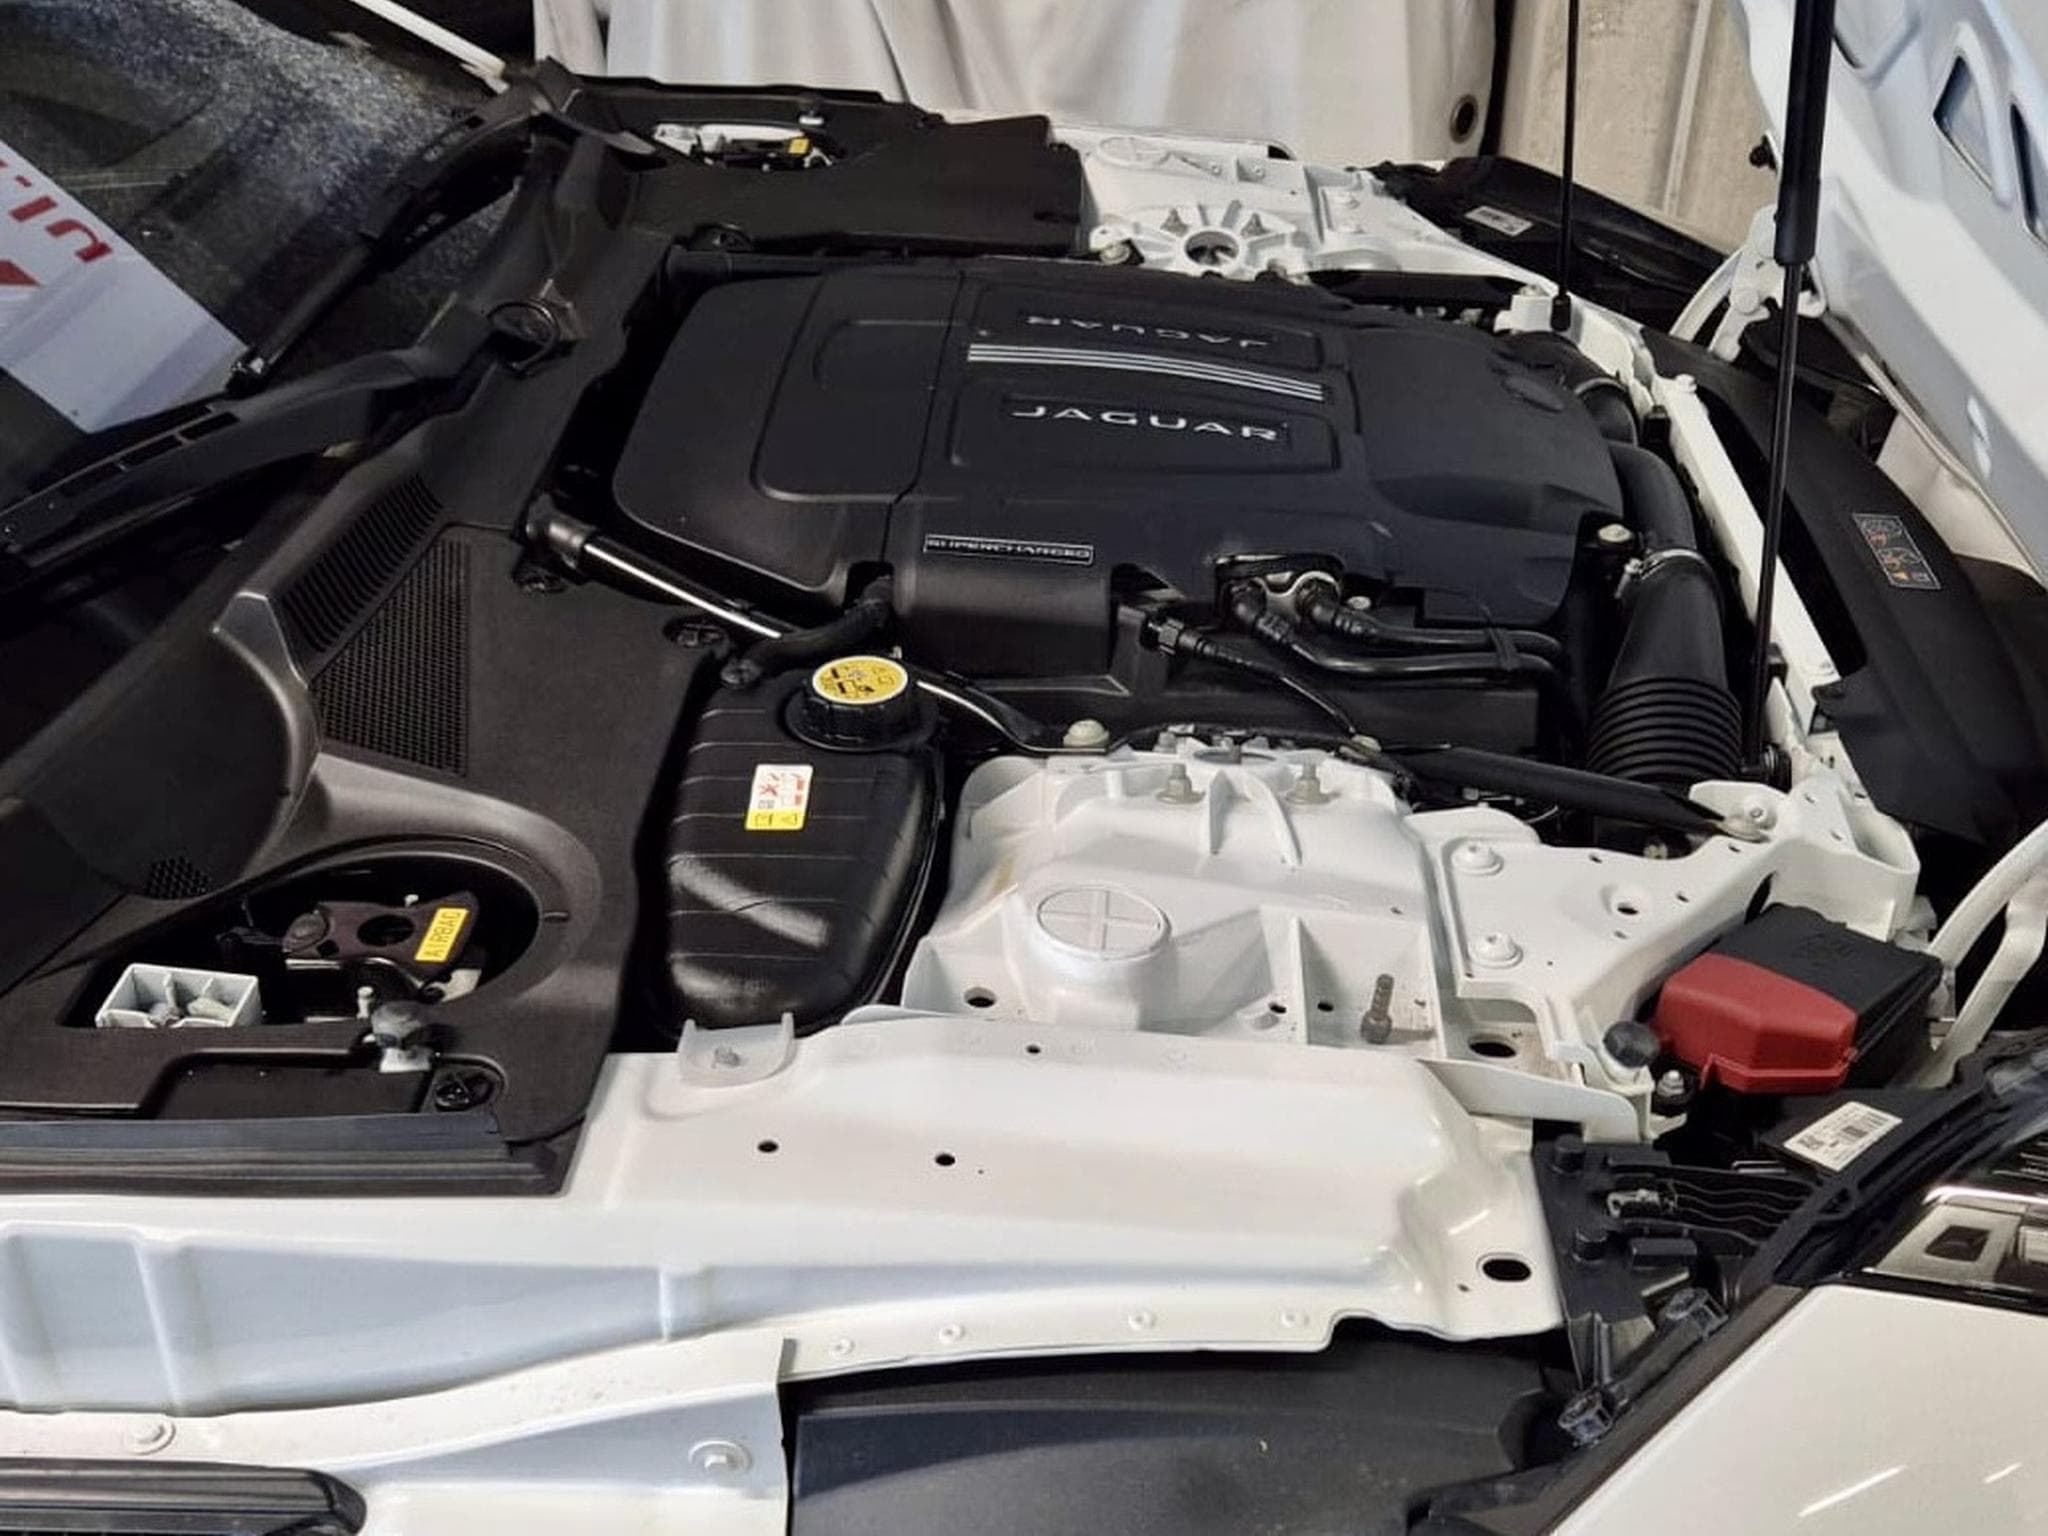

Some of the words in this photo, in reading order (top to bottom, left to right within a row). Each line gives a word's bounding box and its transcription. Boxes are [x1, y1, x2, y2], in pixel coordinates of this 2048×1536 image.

[1026, 315, 1269, 347] JAGUAR
[1011, 406, 1277, 440] JAGUAR
[926, 539, 1091, 560] SUPERCHARGED
[422, 911, 461, 958] AIRBAG
